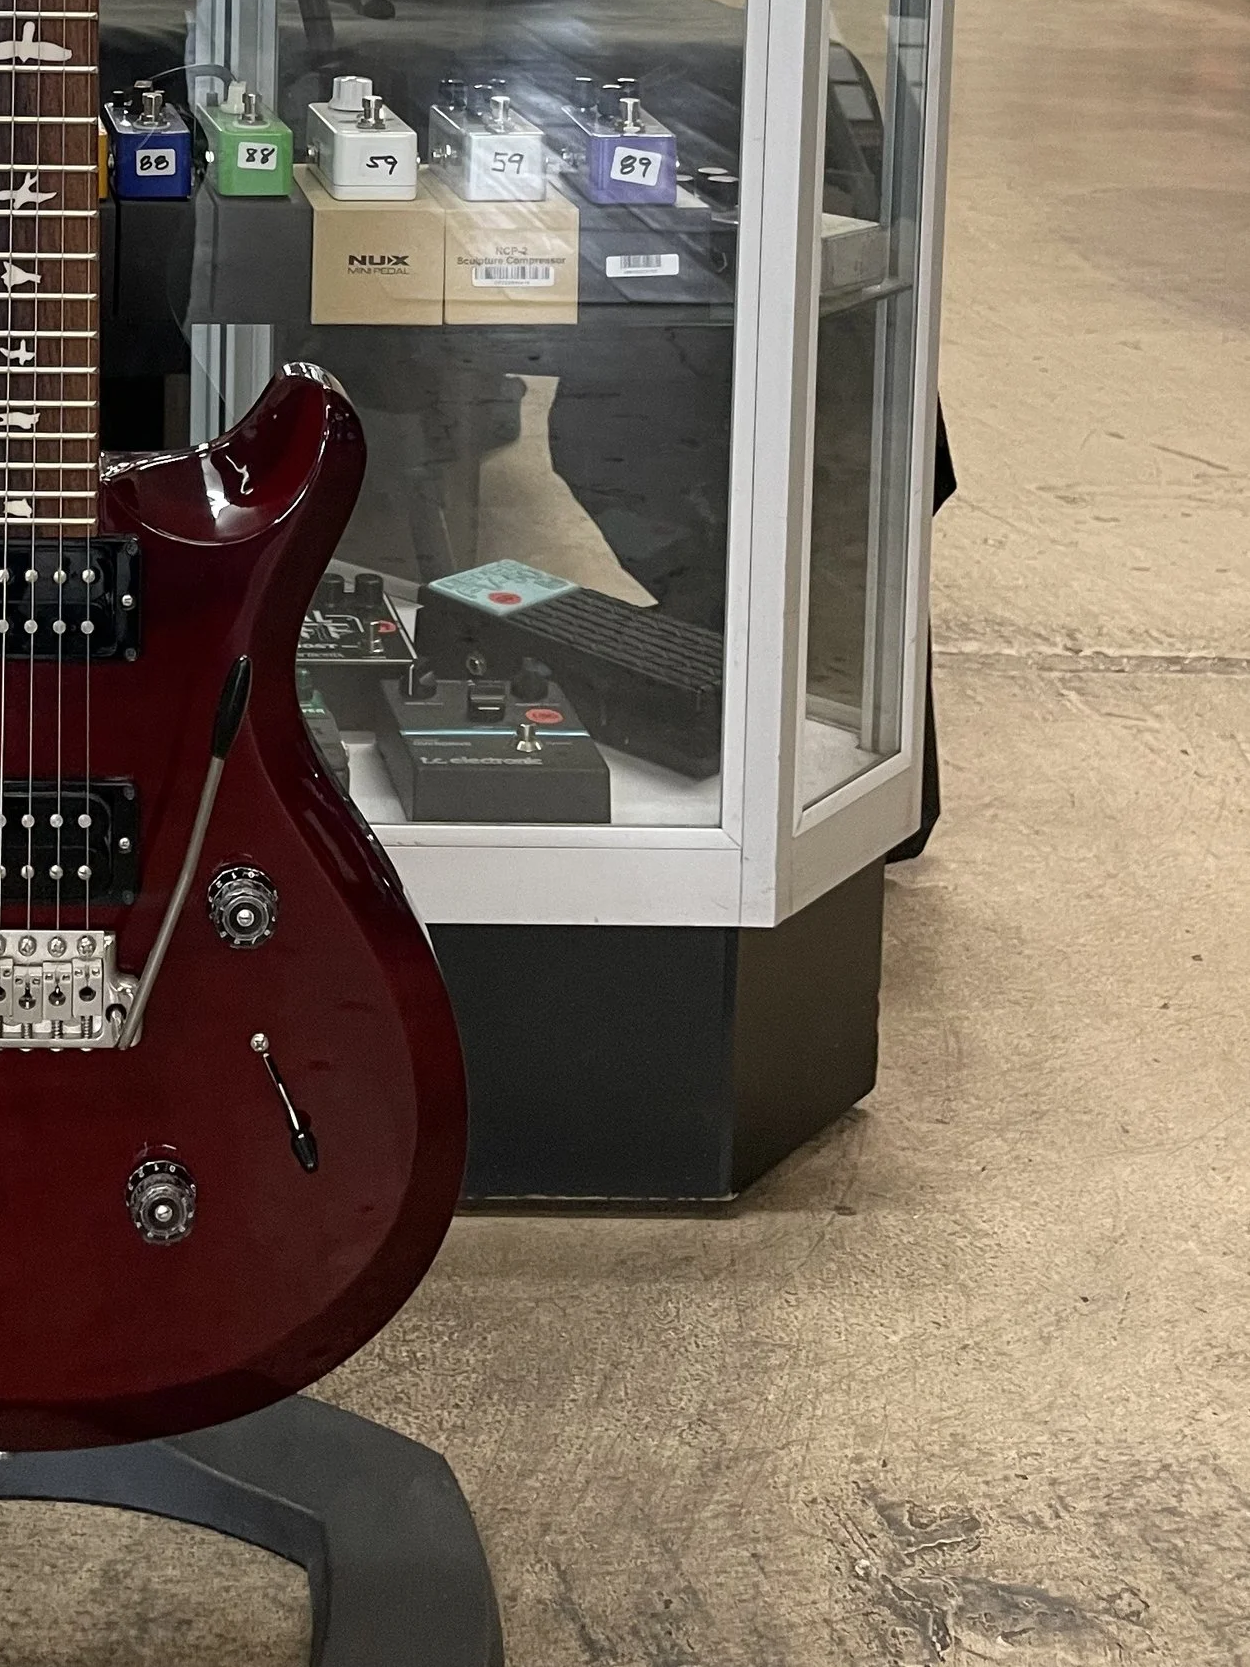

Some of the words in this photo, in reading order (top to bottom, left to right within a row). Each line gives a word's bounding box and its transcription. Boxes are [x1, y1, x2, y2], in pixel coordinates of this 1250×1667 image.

[139, 155, 169, 171] 88
[245, 147, 276, 165] 88
[491, 151, 525, 176] 59
[366, 156, 397, 176] 59
[620, 155, 651, 178] 89
[496, 246, 528, 256] NCP-2
[348, 255, 410, 267] NUX
[457, 256, 504, 266] Sculpture
[505, 256, 566, 266] Compressor
[347, 267, 372, 275] MINI
[373, 267, 410, 275] PEDAL
